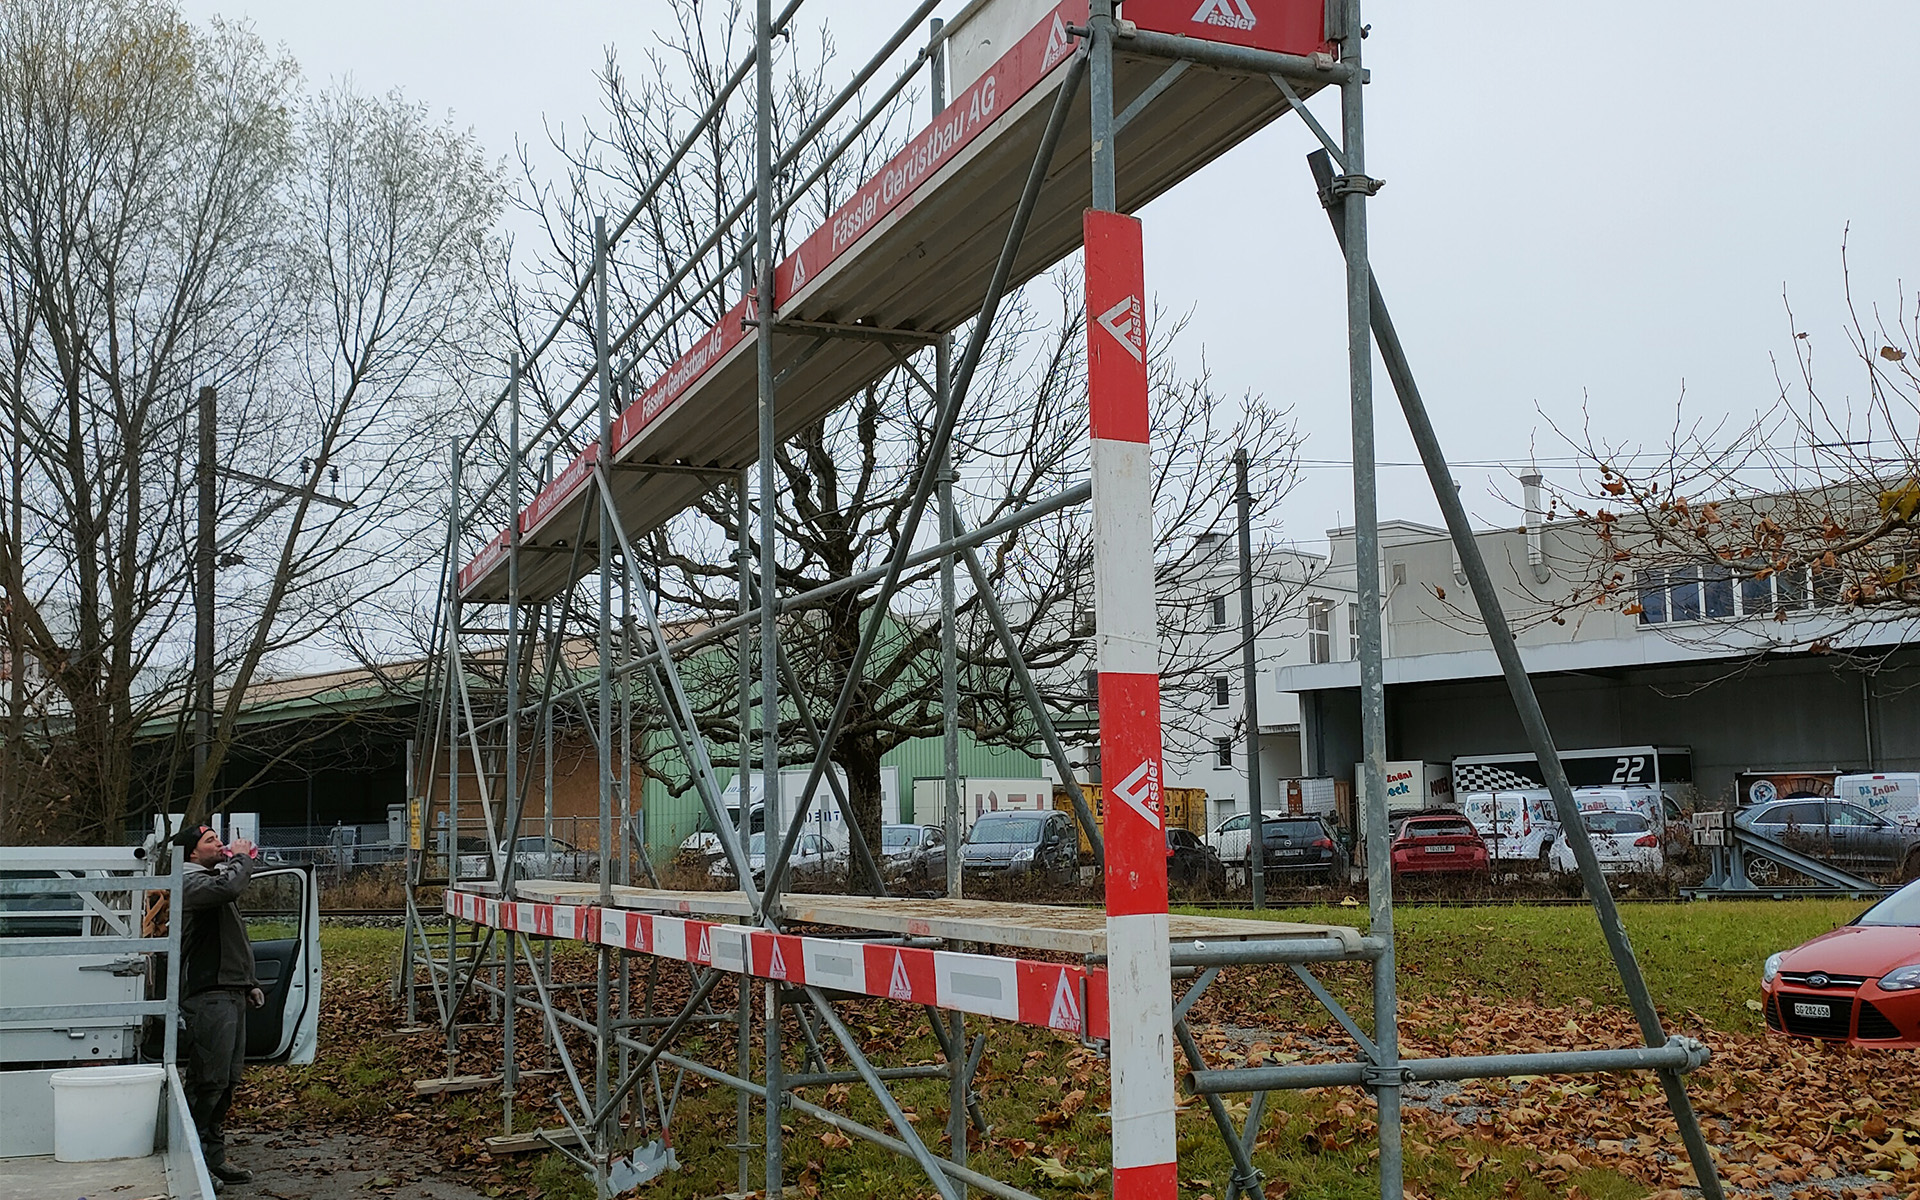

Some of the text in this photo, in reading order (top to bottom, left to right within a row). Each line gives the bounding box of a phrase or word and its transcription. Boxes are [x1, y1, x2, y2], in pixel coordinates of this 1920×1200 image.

[832, 75, 996, 252] Fässler Gerüstbau AG
[708, 326, 722, 362] AG
[1611, 756, 1645, 783] 22
[1387, 782, 1410, 797] eck
